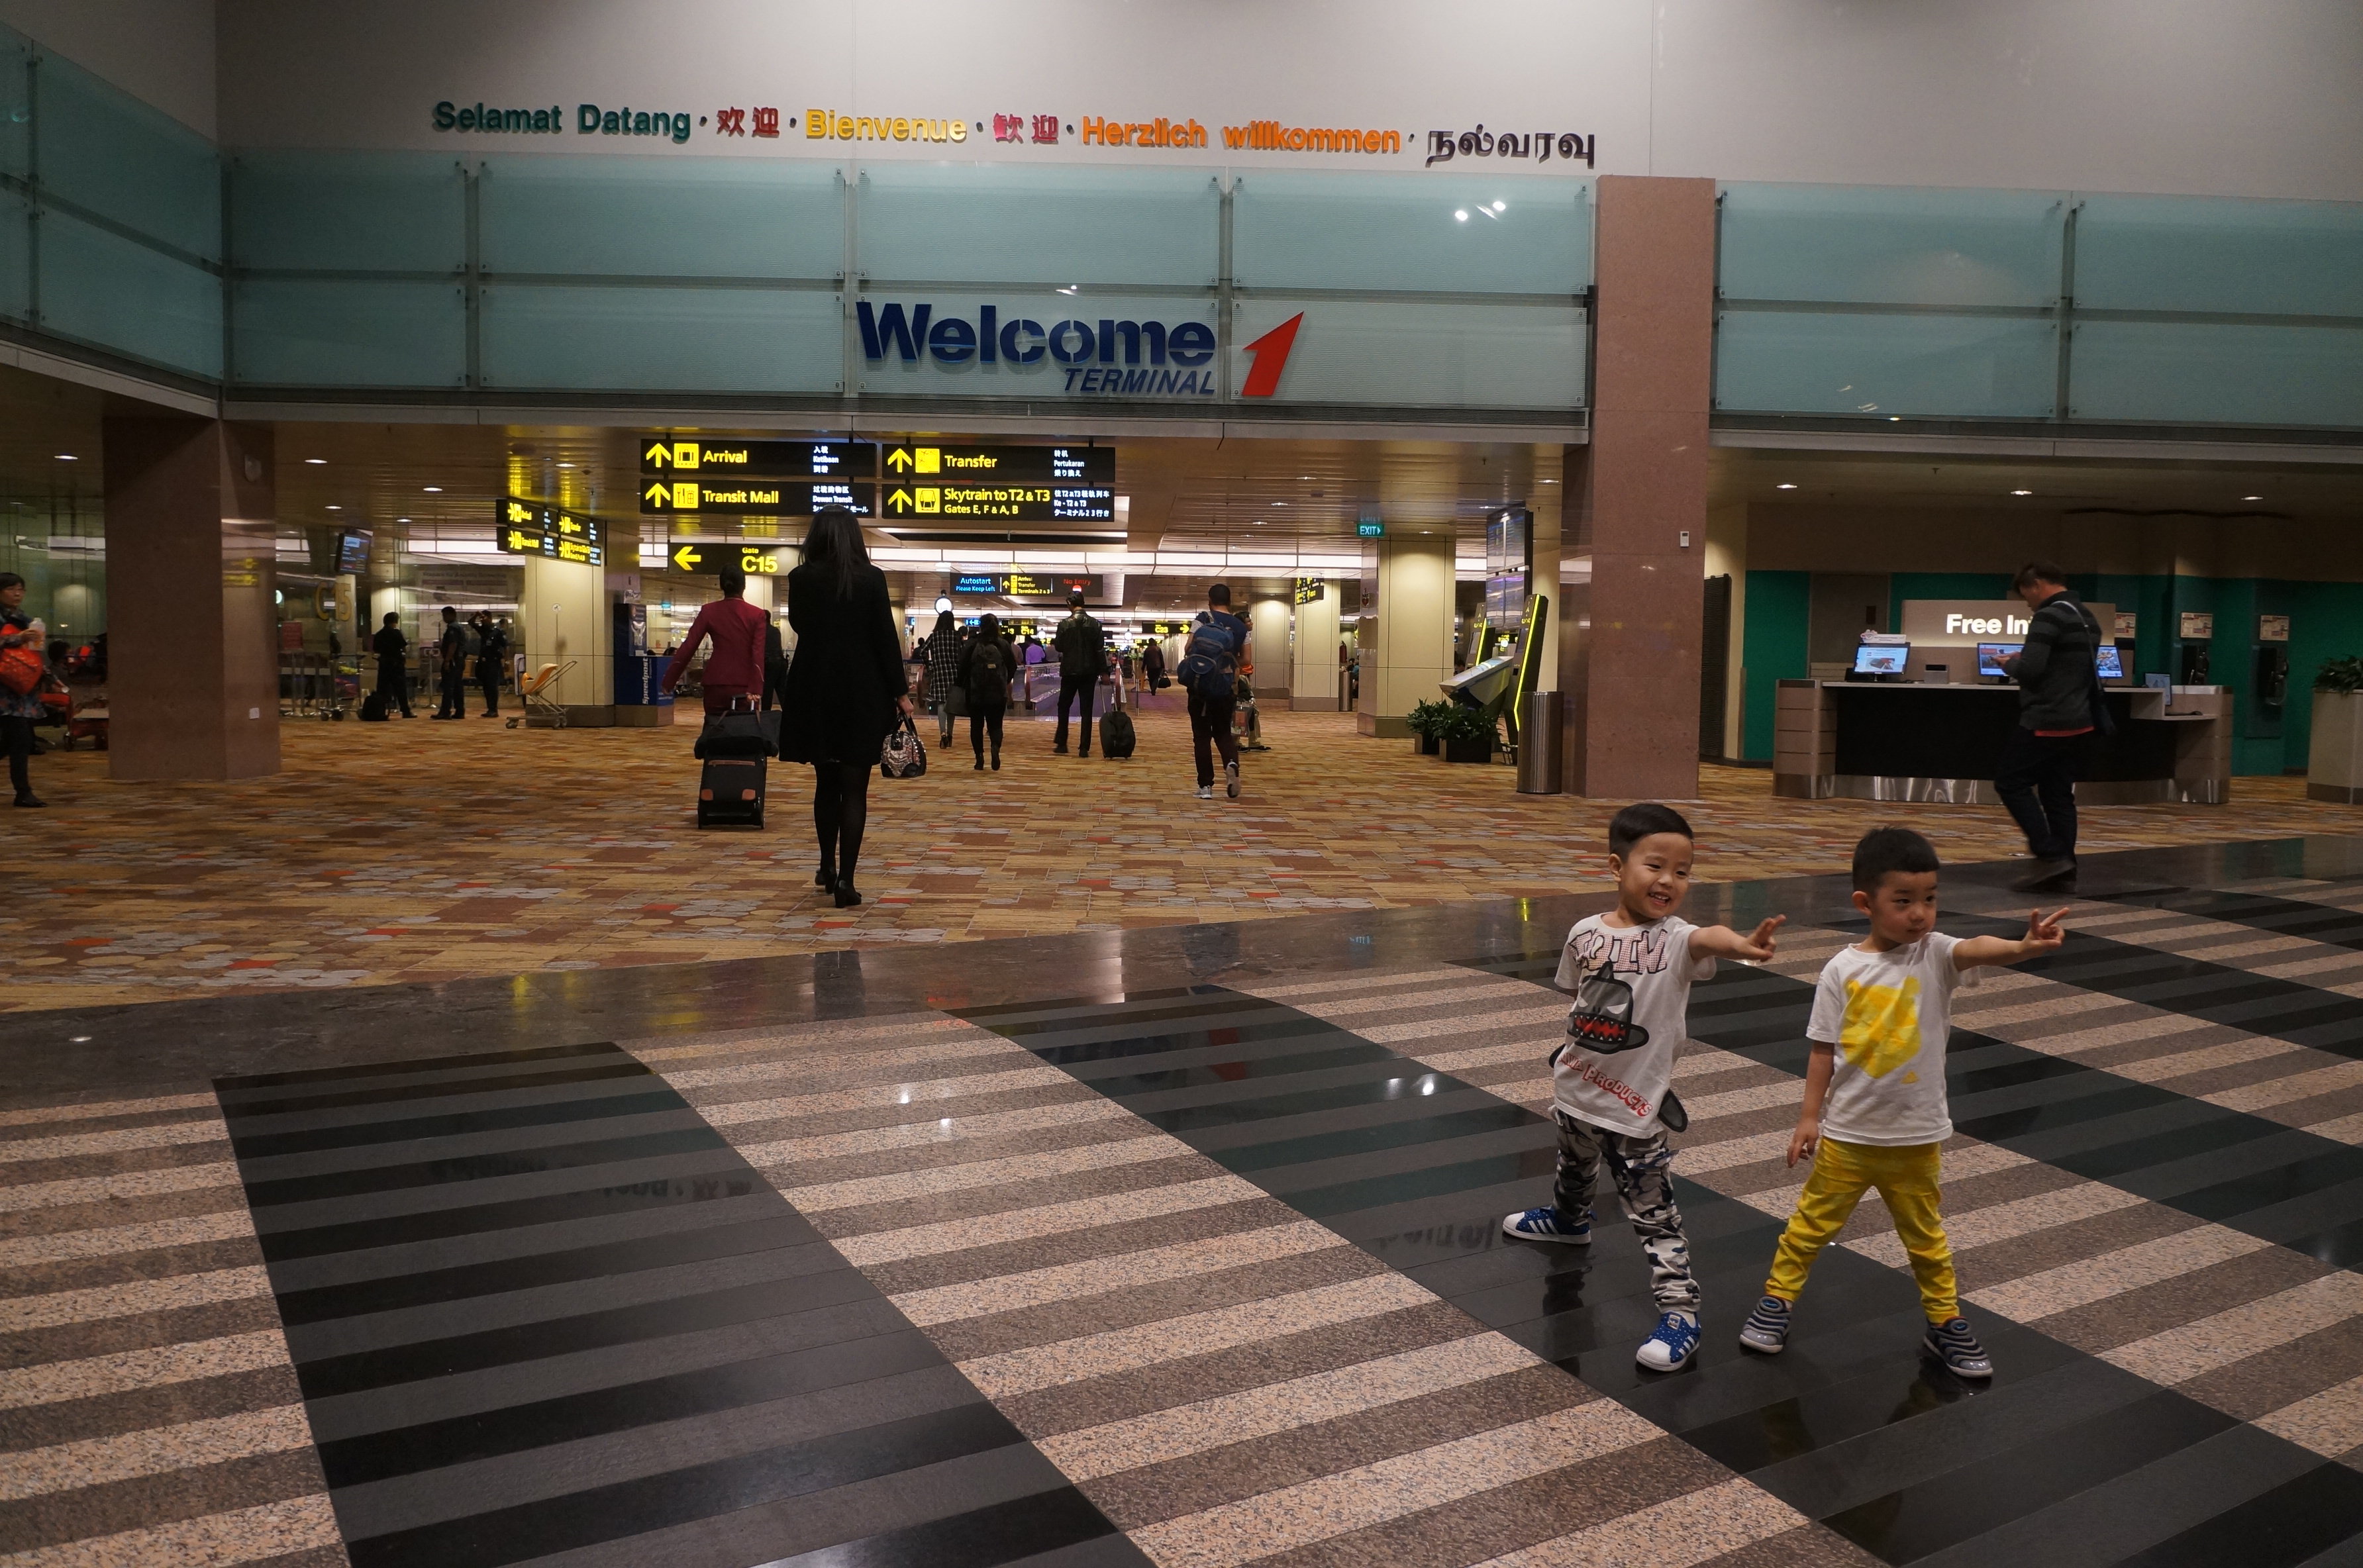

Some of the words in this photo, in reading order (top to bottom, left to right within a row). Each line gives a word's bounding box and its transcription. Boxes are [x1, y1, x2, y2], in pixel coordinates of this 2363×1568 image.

[432, 101, 563, 134] Selamat
[577, 103, 692, 144] Datang
[716, 106, 780, 138] 欢迎
[805, 108, 968, 142] Bienvenue
[1081, 115, 1207, 148] Herzlich
[1224, 120, 1401, 154] willkommen
[1425, 123, 1595, 168] நல்வரவு
[856, 301, 1216, 366] Welcome
[1064, 368, 1216, 395] TERMINAL
[1242, 311, 1305, 397] 1
[703, 450, 748, 464] Arrival
[944, 455, 997, 468] Transfer
[703, 490, 747, 504] Transit
[750, 491, 779, 504] Mall
[812, 495, 833, 503] Dewan
[944, 488, 993, 503] Skytrain
[993, 490, 1008, 501] to
[1008, 489, 1025, 501] T2
[1026, 492, 1034, 501] &
[1034, 489, 1050, 502] T3
[944, 505, 971, 514] Gates
[973, 505, 981, 515] E,
[983, 505, 989, 514] F
[999, 505, 1010, 516] A,
[1011, 505, 1019, 515] B
[1360, 526, 1377, 535] EXIT
[742, 556, 778, 573] C15
[1946, 613, 2002, 634] Free
[1582, 1063, 1653, 1117] PRODUCTS
